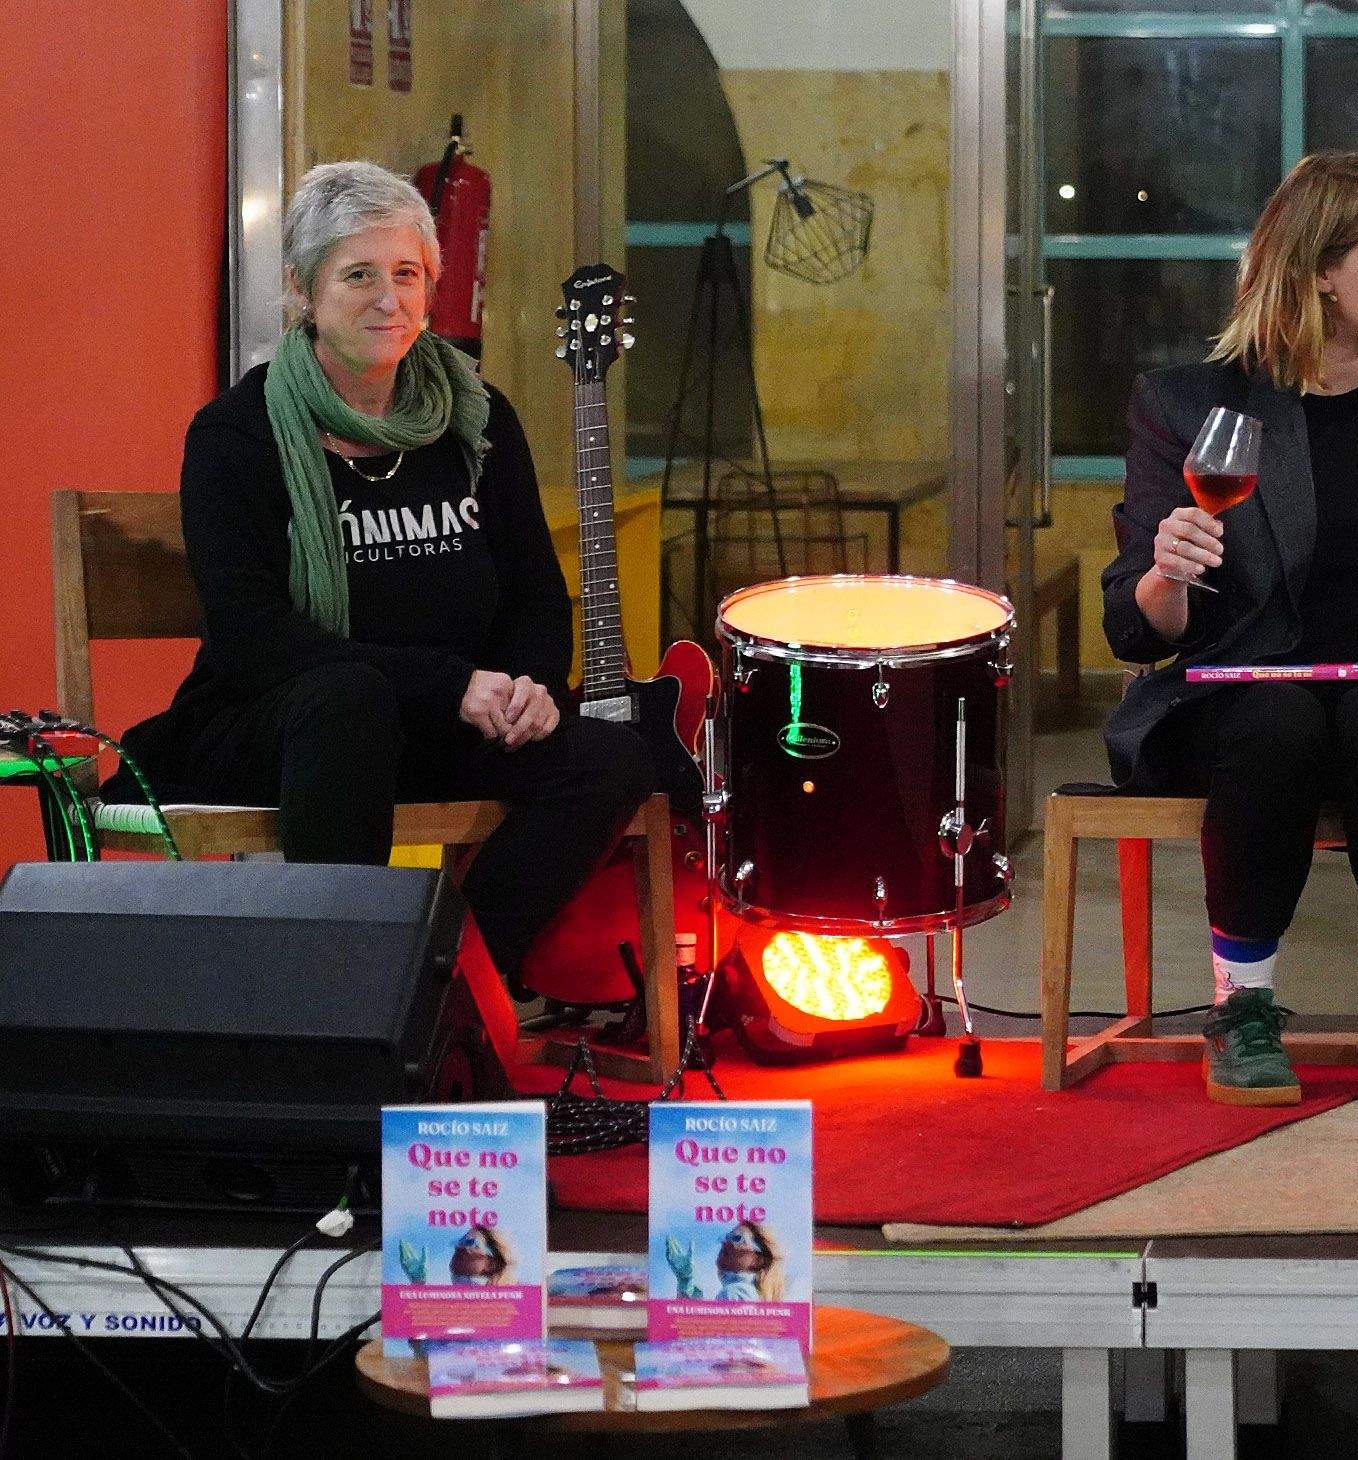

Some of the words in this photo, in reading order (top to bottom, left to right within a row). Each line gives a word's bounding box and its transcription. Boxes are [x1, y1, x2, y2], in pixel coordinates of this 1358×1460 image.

[344, 538, 463, 563] ICULTORAS
[418, 1121, 469, 1136] ROCÍO
[472, 1123, 508, 1136] SAIZ
[685, 1116, 737, 1132] ROCÍO
[740, 1118, 777, 1132] SAIZ
[407, 1142, 470, 1171] Que
[479, 1150, 518, 1169] no
[674, 1138, 738, 1166] Que
[747, 1146, 787, 1165] no
[428, 1179, 461, 1197] se
[468, 1177, 499, 1198] te
[694, 1175, 728, 1194] se
[736, 1173, 767, 1194] te
[428, 1207, 498, 1228] note
[694, 1202, 766, 1223] note
[20, 1313, 71, 1330] VOZ
[80, 1313, 96, 1330] Y
[104, 1313, 201, 1332] SONIDO
